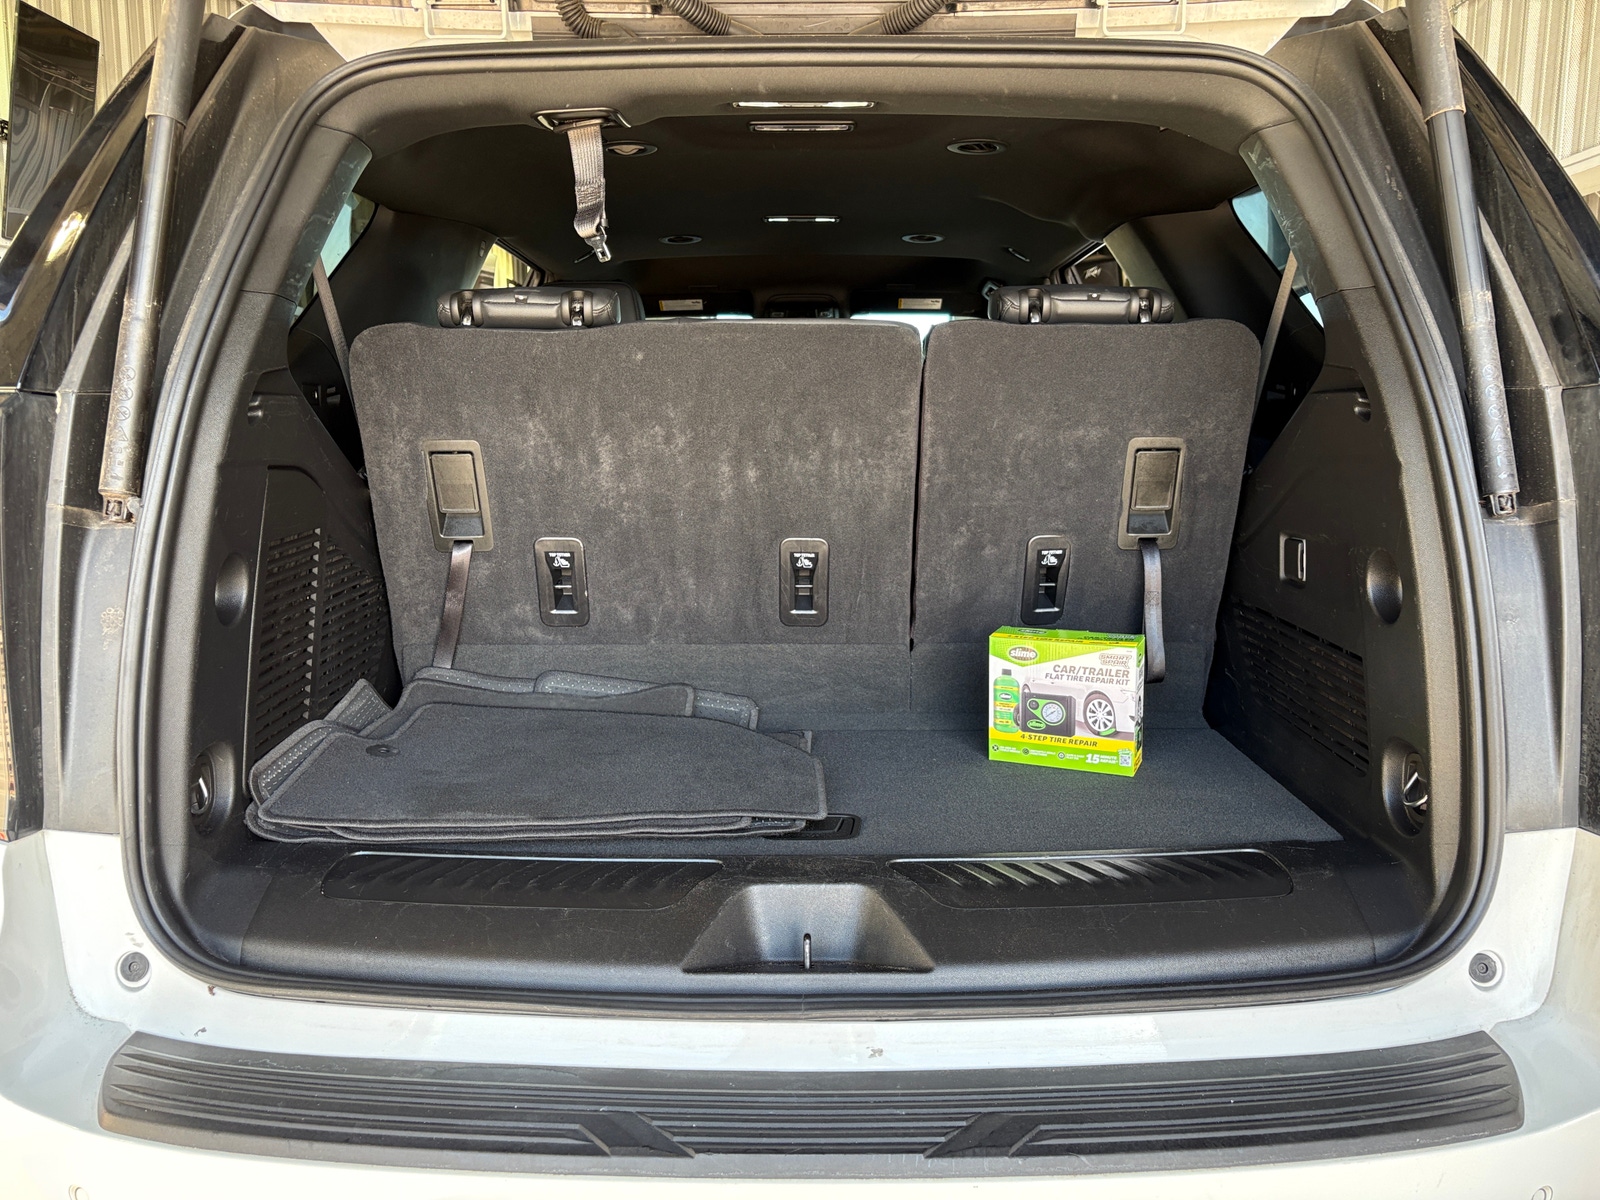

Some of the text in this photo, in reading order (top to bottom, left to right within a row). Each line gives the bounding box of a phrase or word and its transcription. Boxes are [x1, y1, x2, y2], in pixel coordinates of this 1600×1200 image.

[1009, 648, 1036, 658] slime
[1053, 664, 1130, 678] CAR/TRAILER
[1045, 672, 1064, 681] FLAT
[1066, 674, 1084, 682] TIRE
[1085, 676, 1115, 685] REPAIR
[1020, 733, 1098, 747] 4-STEP TIRE REPAIR
[1086, 753, 1100, 764] 15
